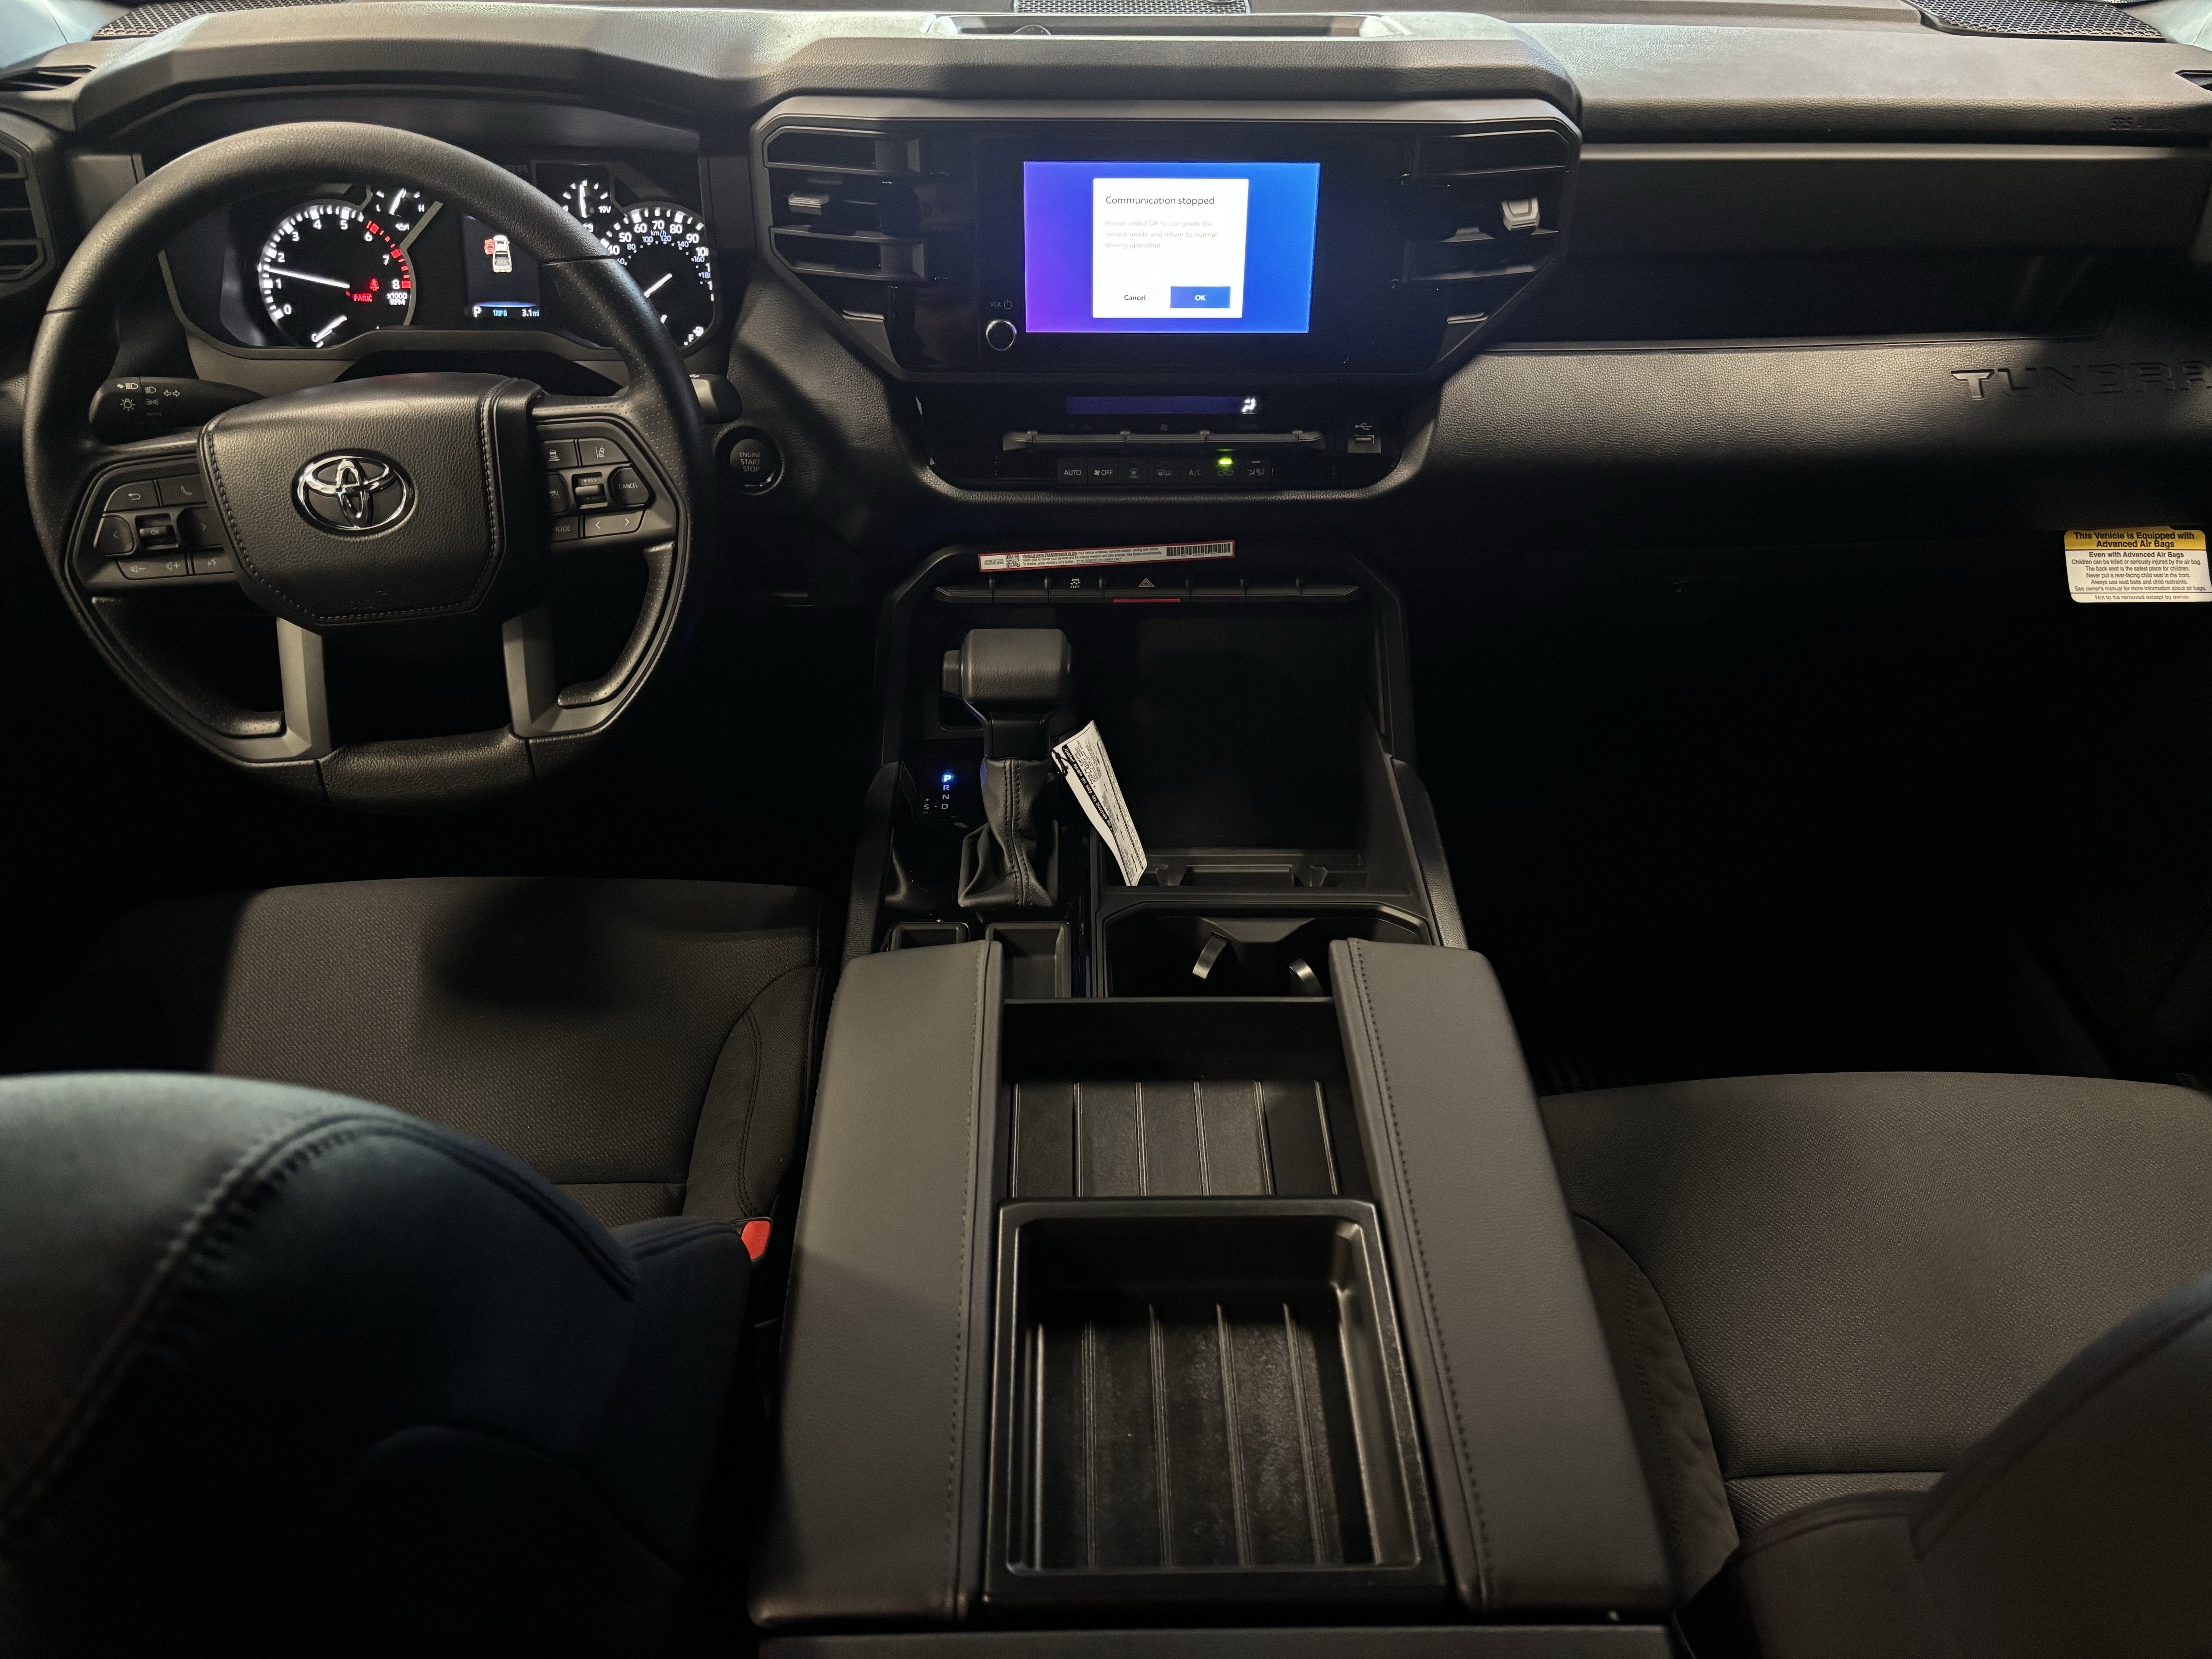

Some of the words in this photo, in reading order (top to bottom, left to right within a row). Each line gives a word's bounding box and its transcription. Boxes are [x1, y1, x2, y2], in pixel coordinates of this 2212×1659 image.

[1106, 196, 1175, 204] Communication
[1178, 196, 1215, 206] stopped
[376, 203, 381, 212] L
[418, 204, 424, 212] H
[598, 205, 611, 213] 19V
[313, 220, 322, 230] 4
[340, 219, 348, 230] 5
[634, 223, 647, 233] 60
[652, 220, 665, 230] 70
[670, 224, 683, 234] 80
[292, 231, 300, 241] 3
[364, 233, 373, 242] 6
[619, 232, 632, 242] 50
[686, 233, 699, 244] 90
[278, 252, 285, 263] 2
[383, 255, 390, 265] 7
[276, 279, 282, 289] 1
[392, 279, 400, 290] 8
[353, 294, 373, 302] PARK
[283, 304, 292, 315] 0
[473, 306, 482, 318] P
[522, 309, 532, 317] 3.1
[689, 334, 694, 342] F
[2136, 532, 2175, 541] Equipped
[2154, 540, 2175, 549] Bags
